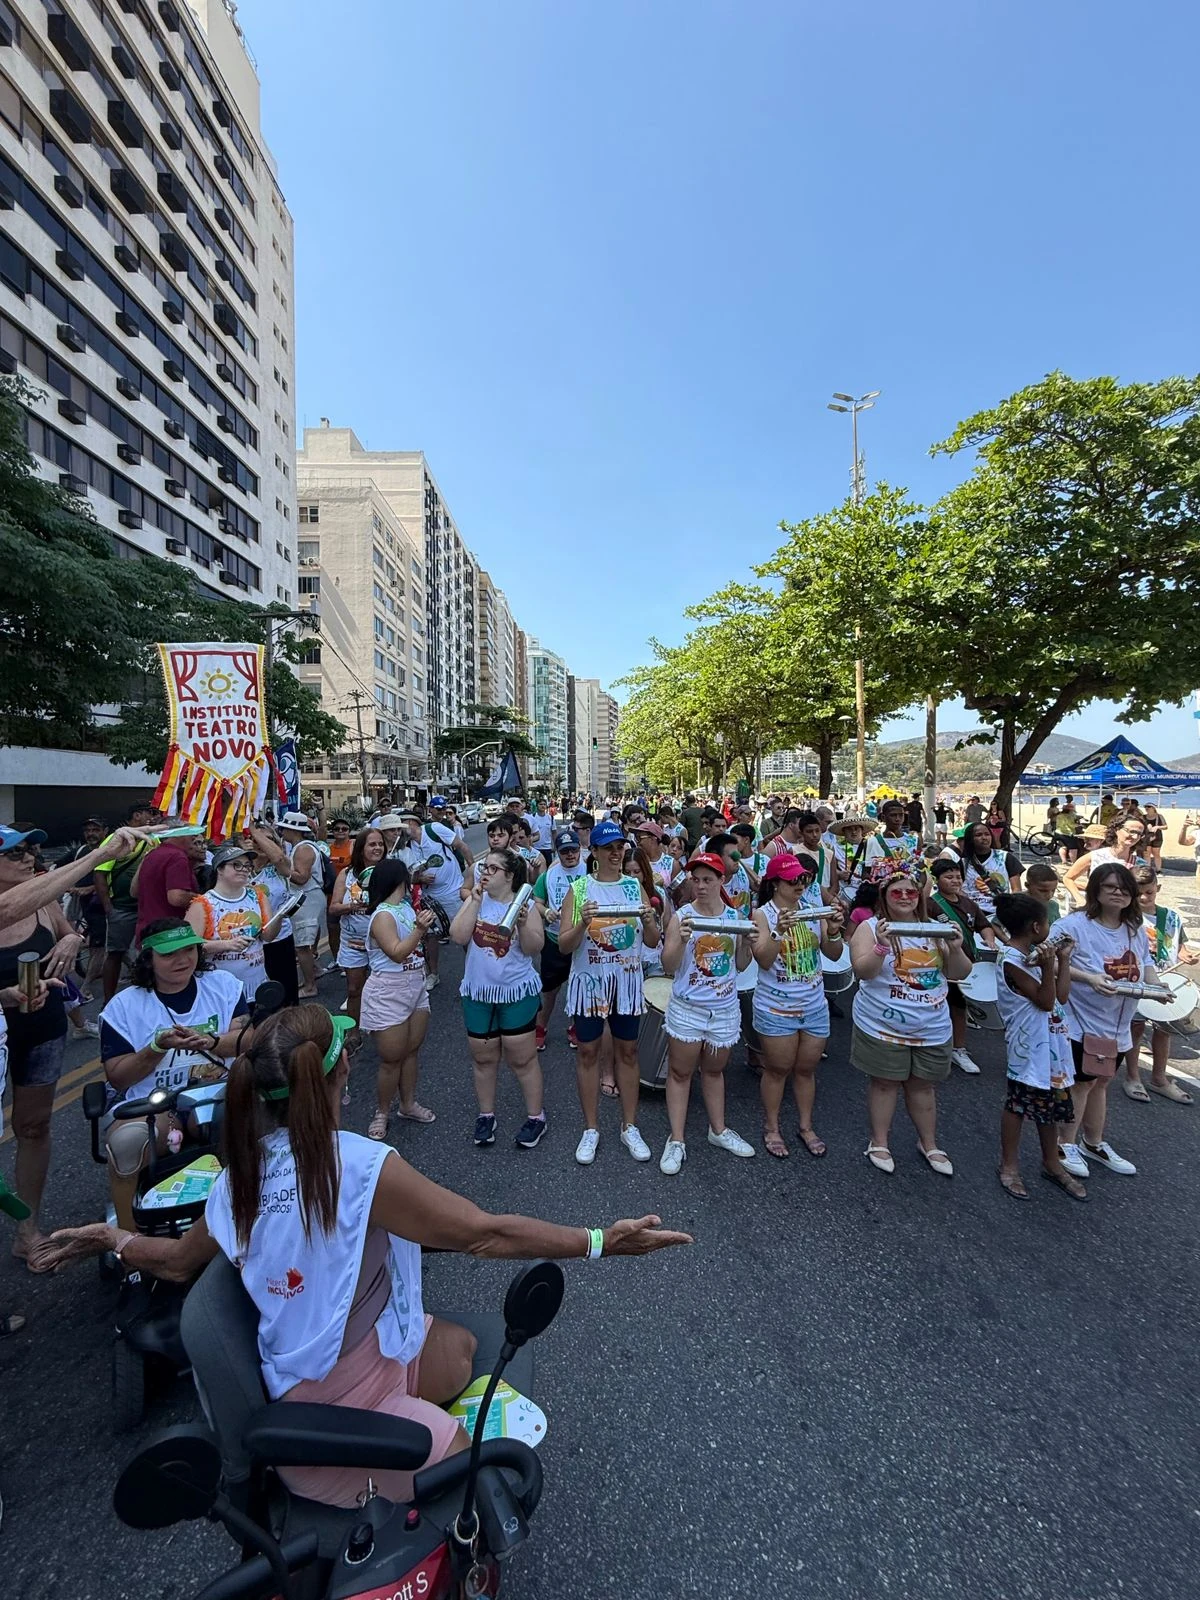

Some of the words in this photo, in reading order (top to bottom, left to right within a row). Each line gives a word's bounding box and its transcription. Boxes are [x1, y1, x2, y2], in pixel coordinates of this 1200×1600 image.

[182, 704, 257, 720] INSTITUTO
[184, 719, 257, 739] TEATRO
[192, 738, 256, 763] NOVO
[416, 1571, 429, 1594] S
